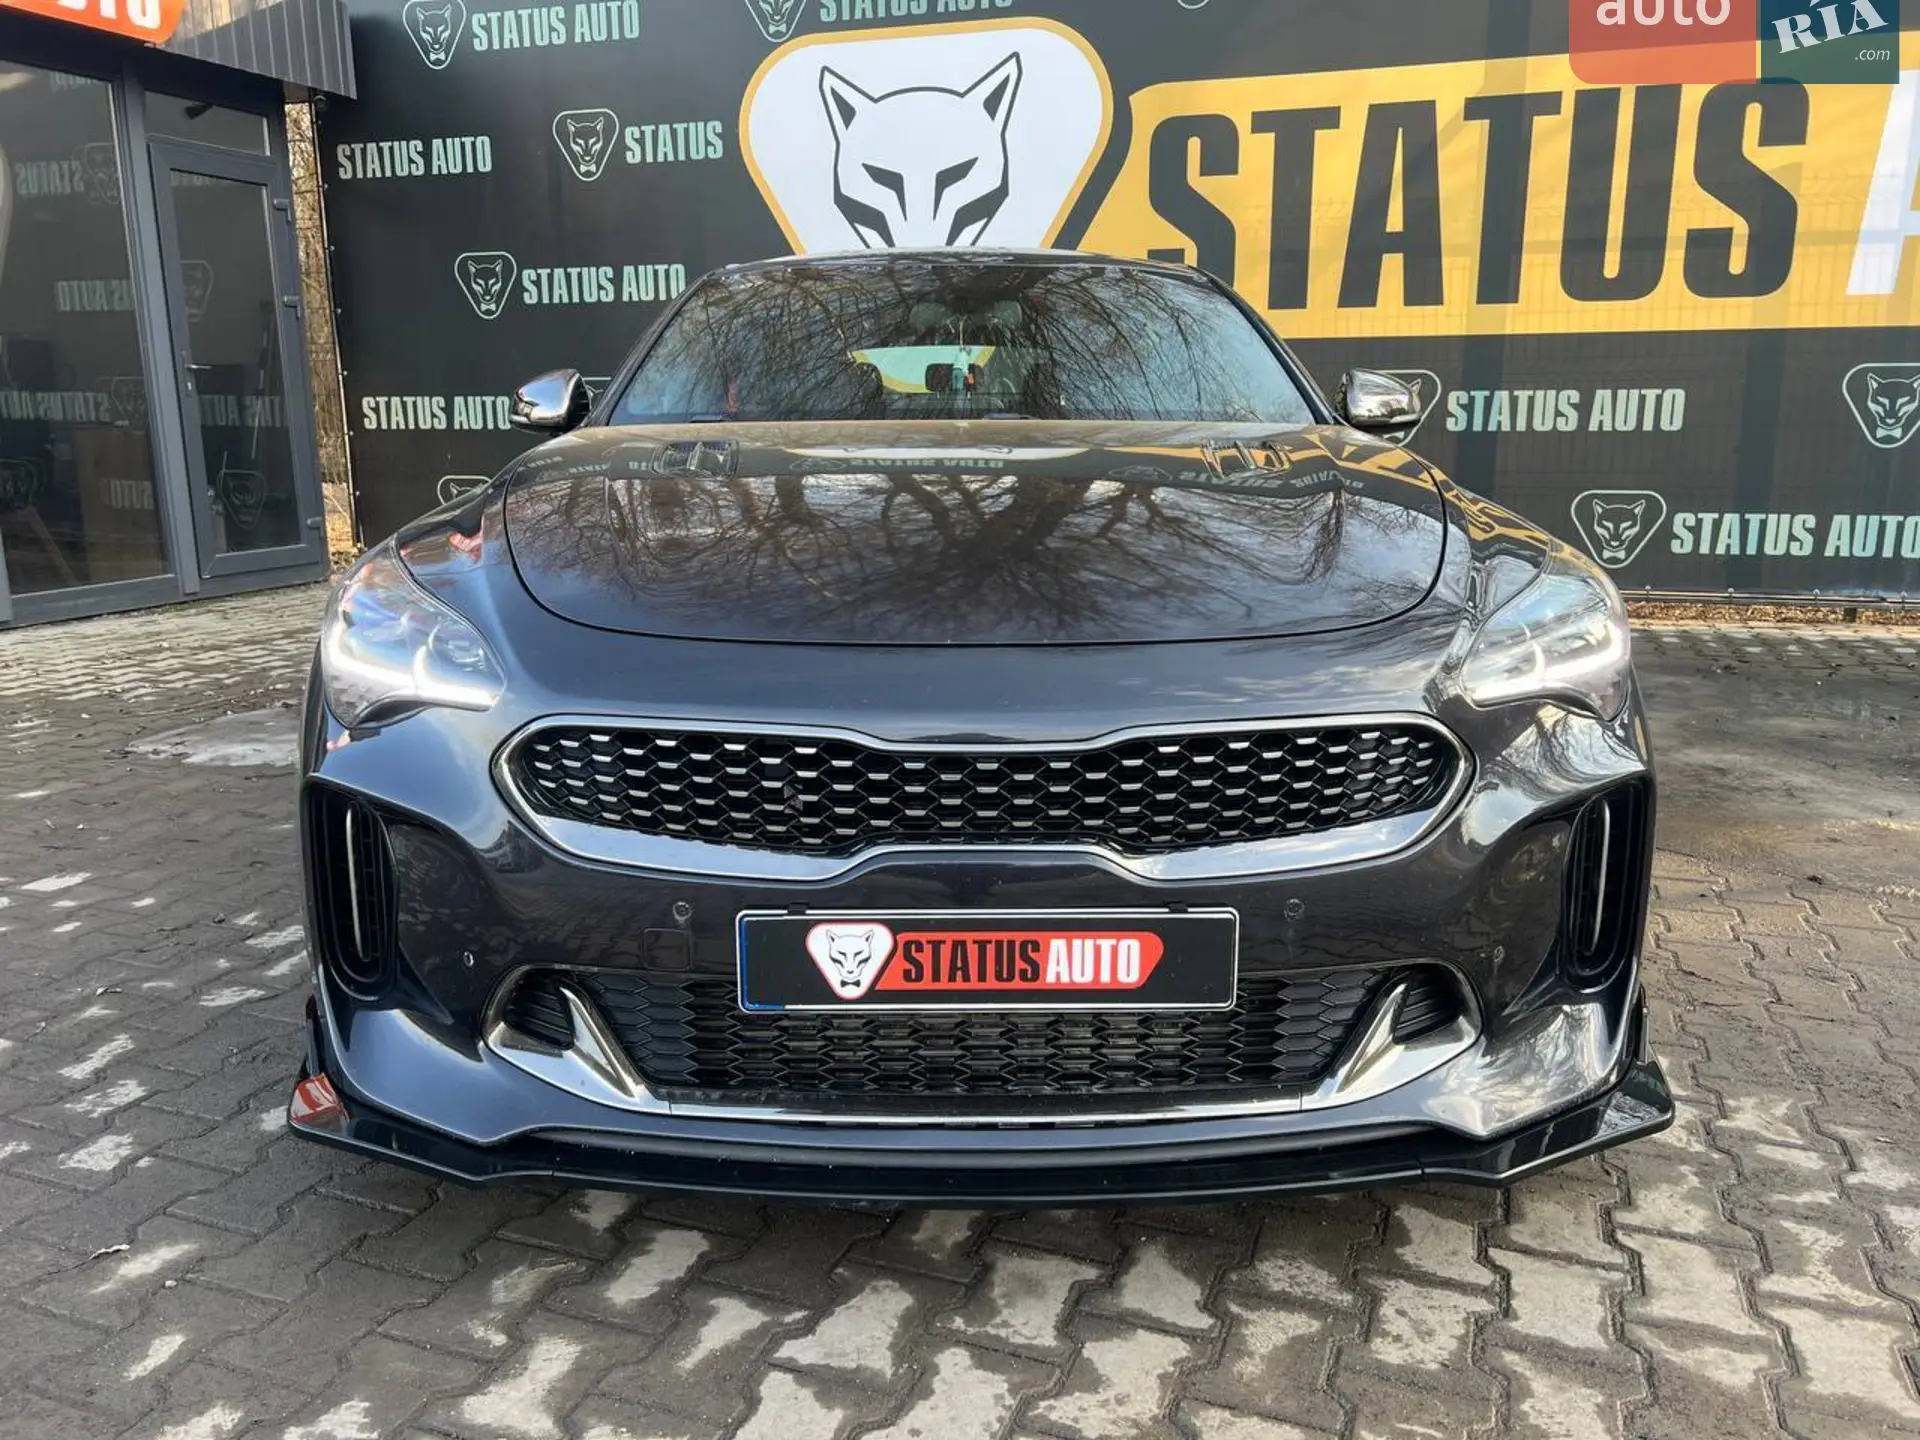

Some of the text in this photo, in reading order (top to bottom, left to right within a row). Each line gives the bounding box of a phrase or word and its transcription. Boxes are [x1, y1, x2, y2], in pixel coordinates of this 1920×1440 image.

[472, 0, 639, 51] STATUS AUTO
[336, 135, 493, 180] STATUS AUTO
[624, 120, 724, 164] STATUS
[1147, 77, 1810, 310] STATUS
[522, 263, 687, 304] STATUS AUTO
[362, 396, 512, 430] STATUS AUTO
[1446, 388, 1686, 432] STATUS AUTO
[1670, 512, 1920, 558] STATUS AUTO
